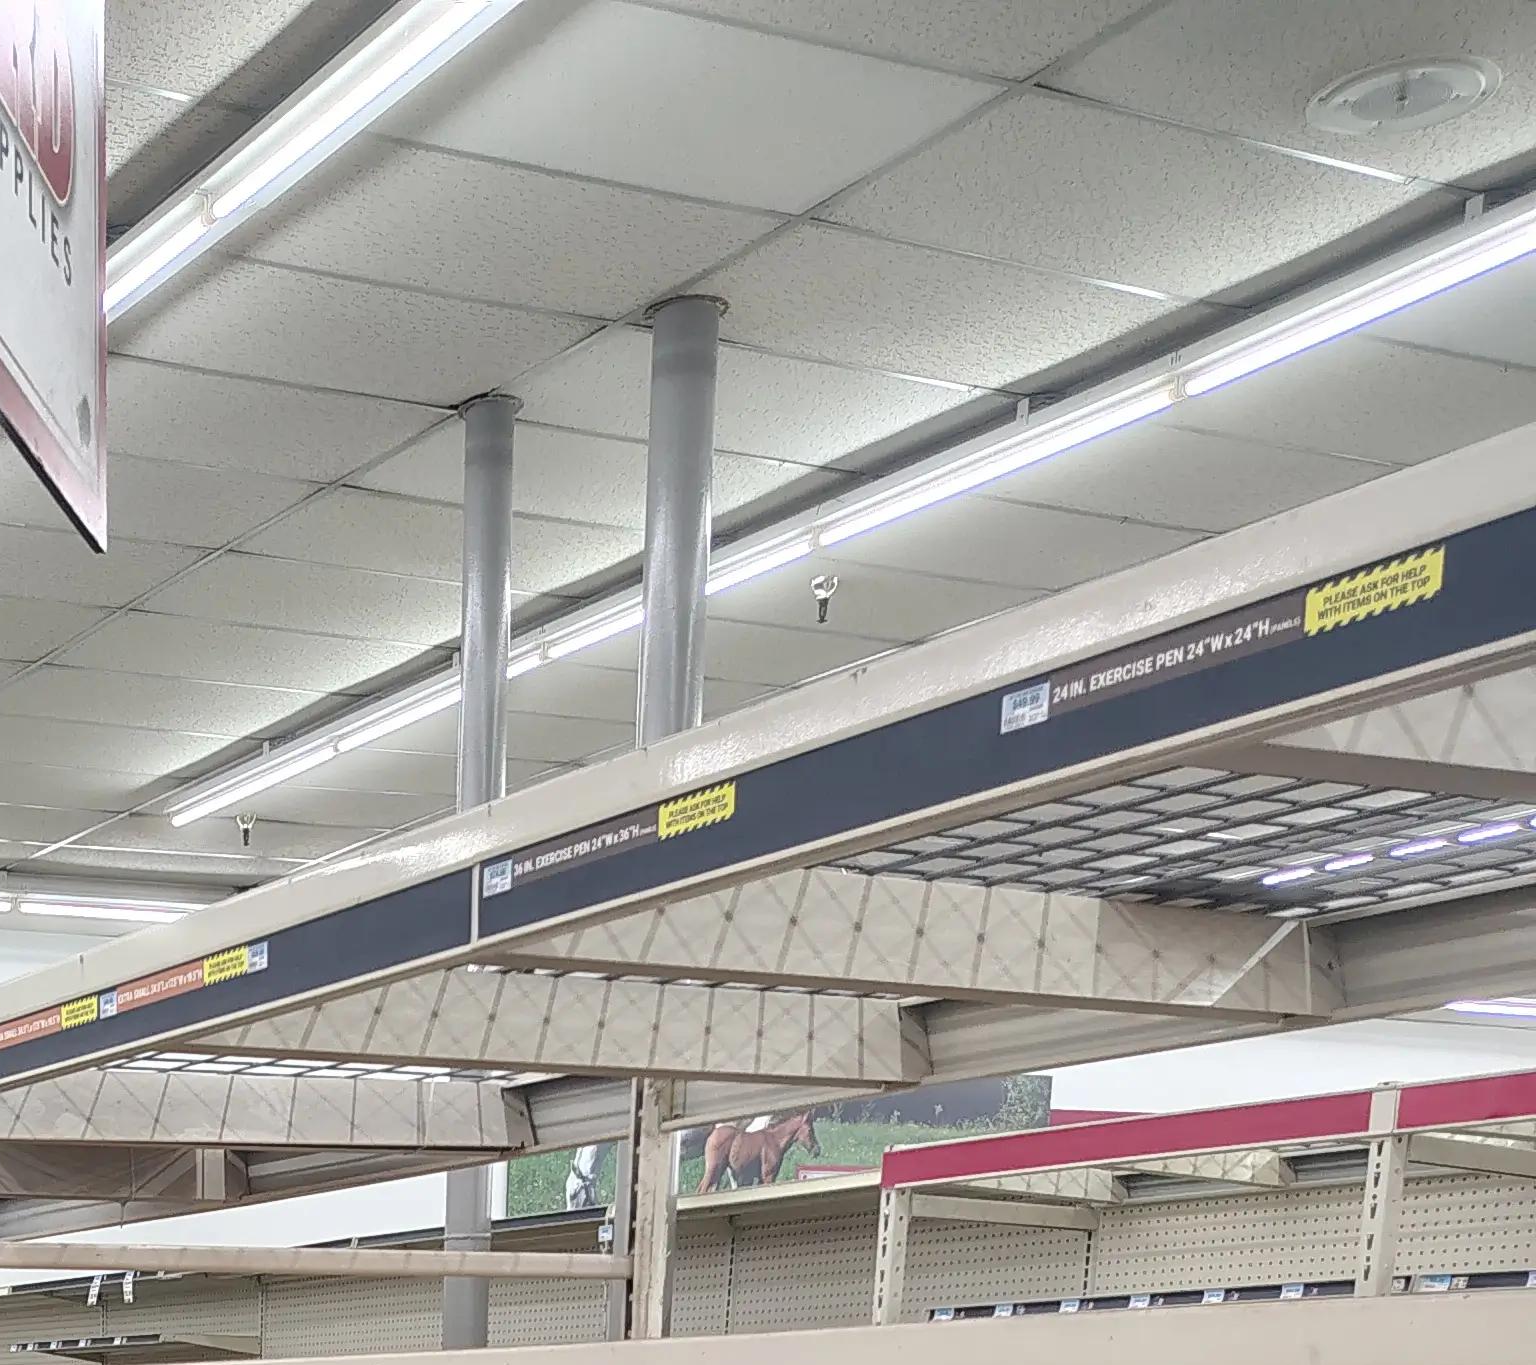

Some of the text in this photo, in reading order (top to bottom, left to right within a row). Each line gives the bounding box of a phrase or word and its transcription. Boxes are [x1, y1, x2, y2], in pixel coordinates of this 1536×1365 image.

[1317, 575, 1431, 620] WITH ITEMS ON THE TOP
[1323, 565, 1427, 607] PLEASE ASK FOR HELP
[1052, 686, 1069, 704] 24
[1070, 680, 1087, 699] IN.
[1089, 657, 1153, 693] EXERCISE
[1156, 648, 1183, 672] PEN
[535, 844, 573, 872] EXERCISE
[573, 840, 591, 860] PEN
